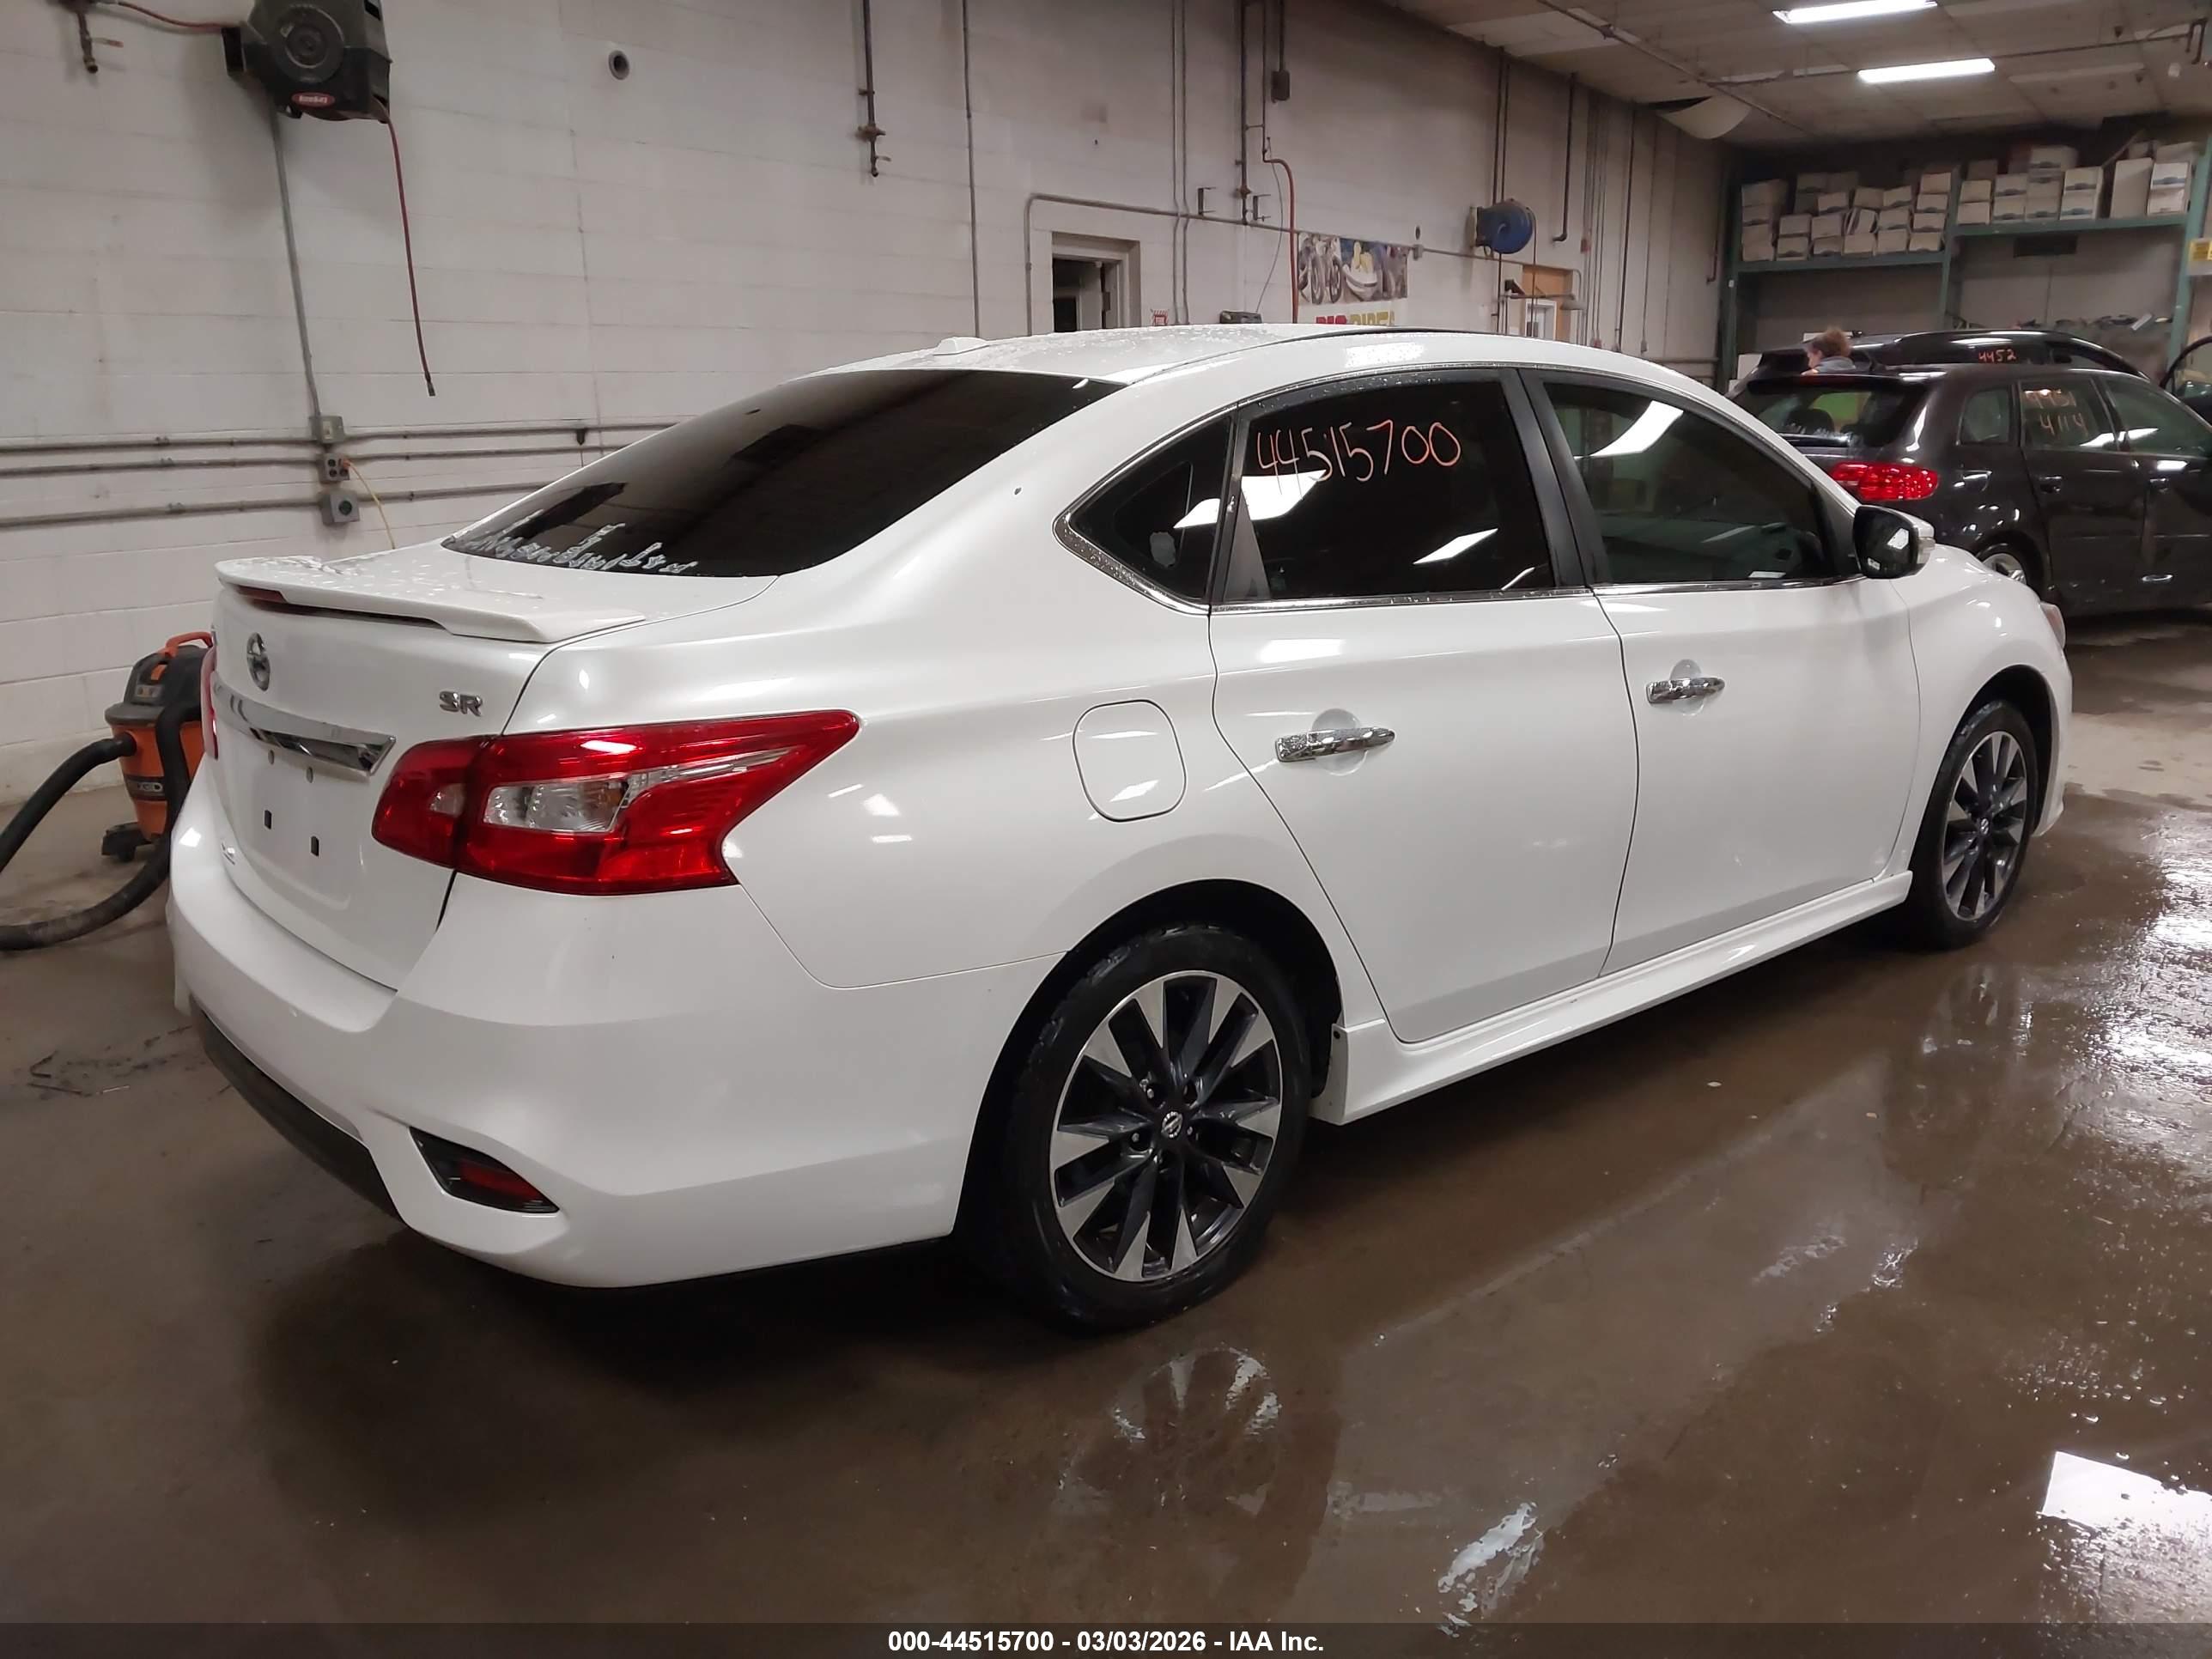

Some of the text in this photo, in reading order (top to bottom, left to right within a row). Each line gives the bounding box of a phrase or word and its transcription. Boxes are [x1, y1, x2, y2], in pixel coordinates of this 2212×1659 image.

[1978, 349, 2017, 362] 4452
[1256, 419, 1462, 499] 44515700
[439, 690, 483, 718] SR
